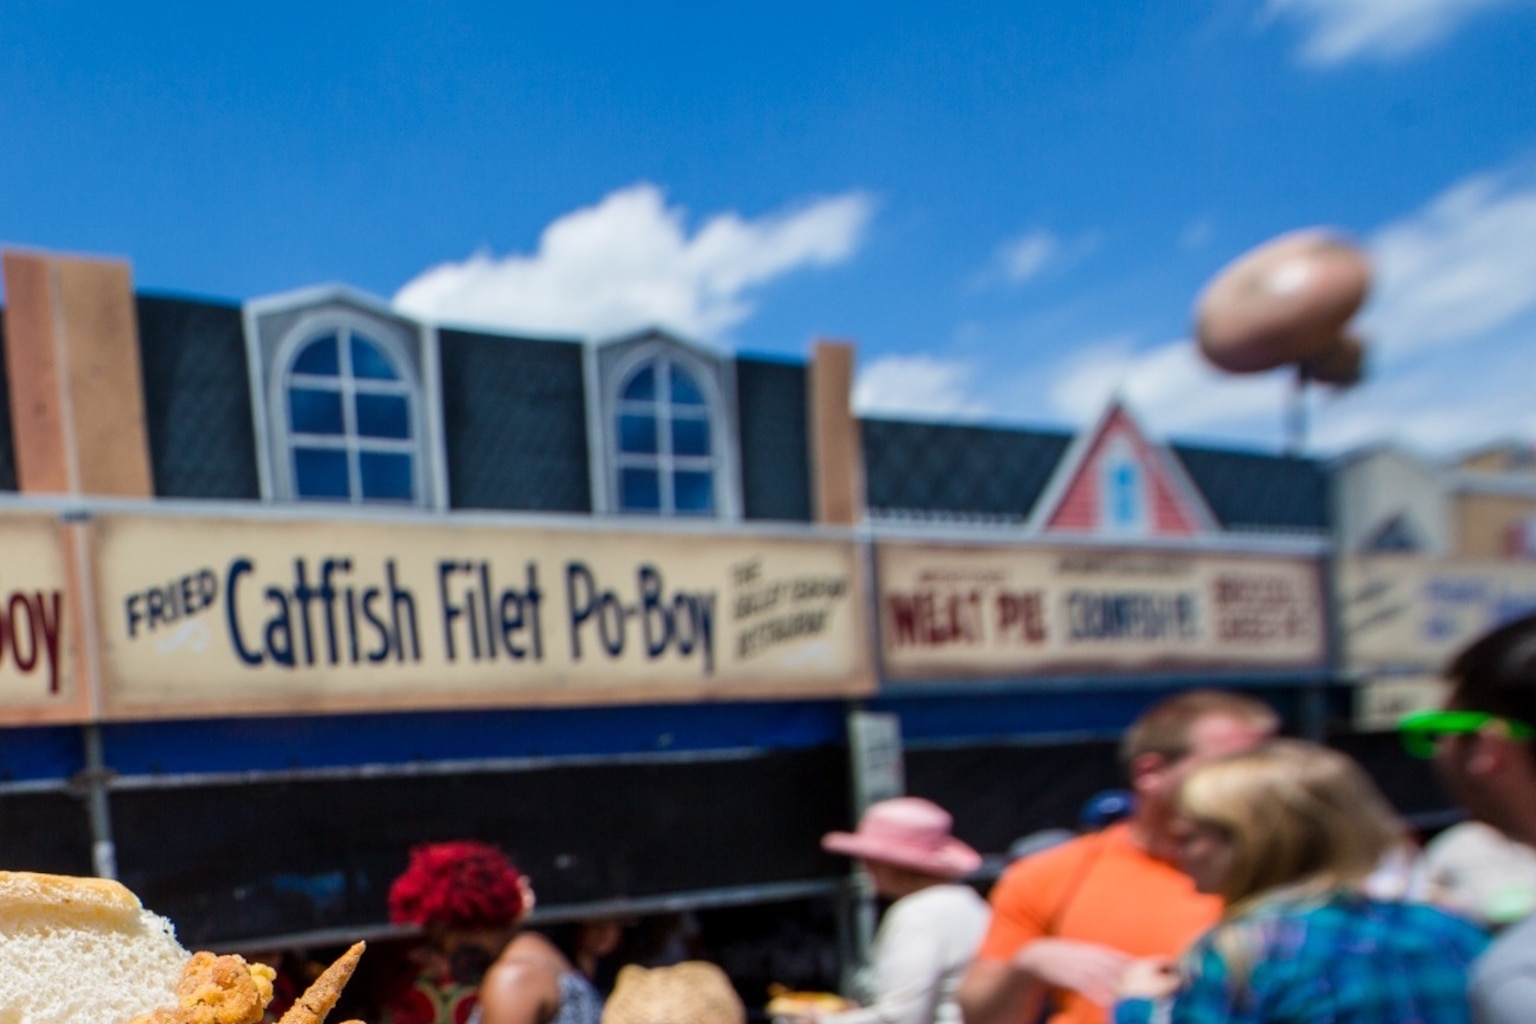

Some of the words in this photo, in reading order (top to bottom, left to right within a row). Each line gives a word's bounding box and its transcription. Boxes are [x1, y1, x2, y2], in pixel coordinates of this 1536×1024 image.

[124, 568, 218, 638] FRIED
[226, 557, 422, 669] Catfish
[438, 560, 544, 661] Filet
[565, 560, 717, 674] Po-Boy
